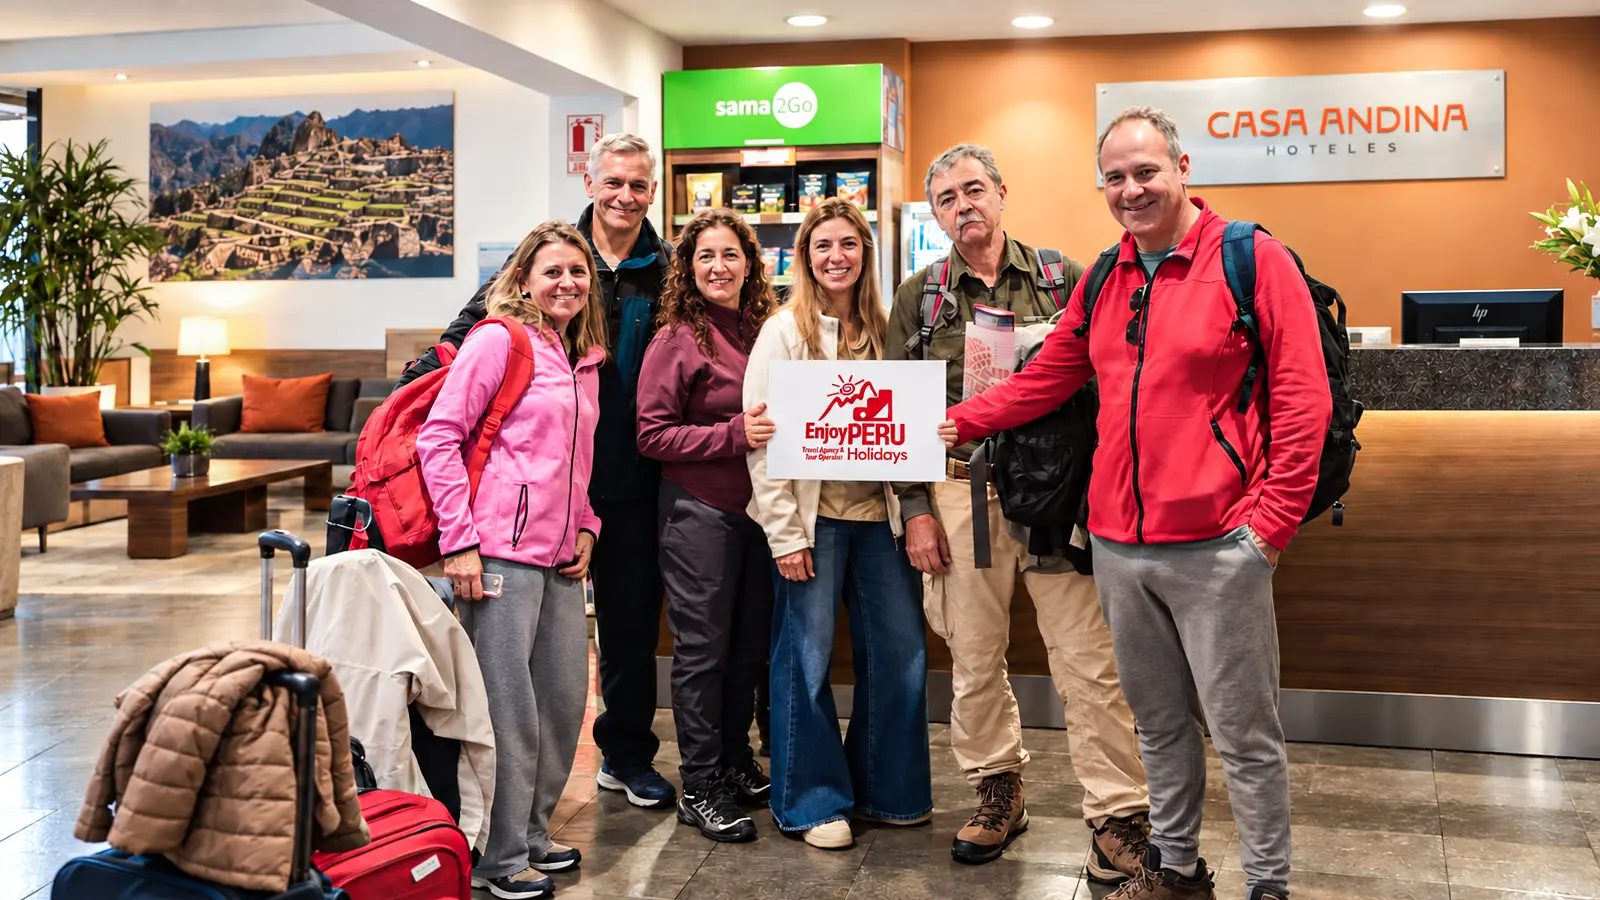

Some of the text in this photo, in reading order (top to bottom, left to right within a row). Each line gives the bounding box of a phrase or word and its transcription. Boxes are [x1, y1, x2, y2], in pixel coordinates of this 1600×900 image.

[715, 96, 813, 116] sama 2Go
[1207, 103, 1469, 138] CASA ANDINA
[1266, 142, 1397, 157] HOTELES
[1472, 304, 1488, 323] hp
[847, 447, 908, 464] Holidays
